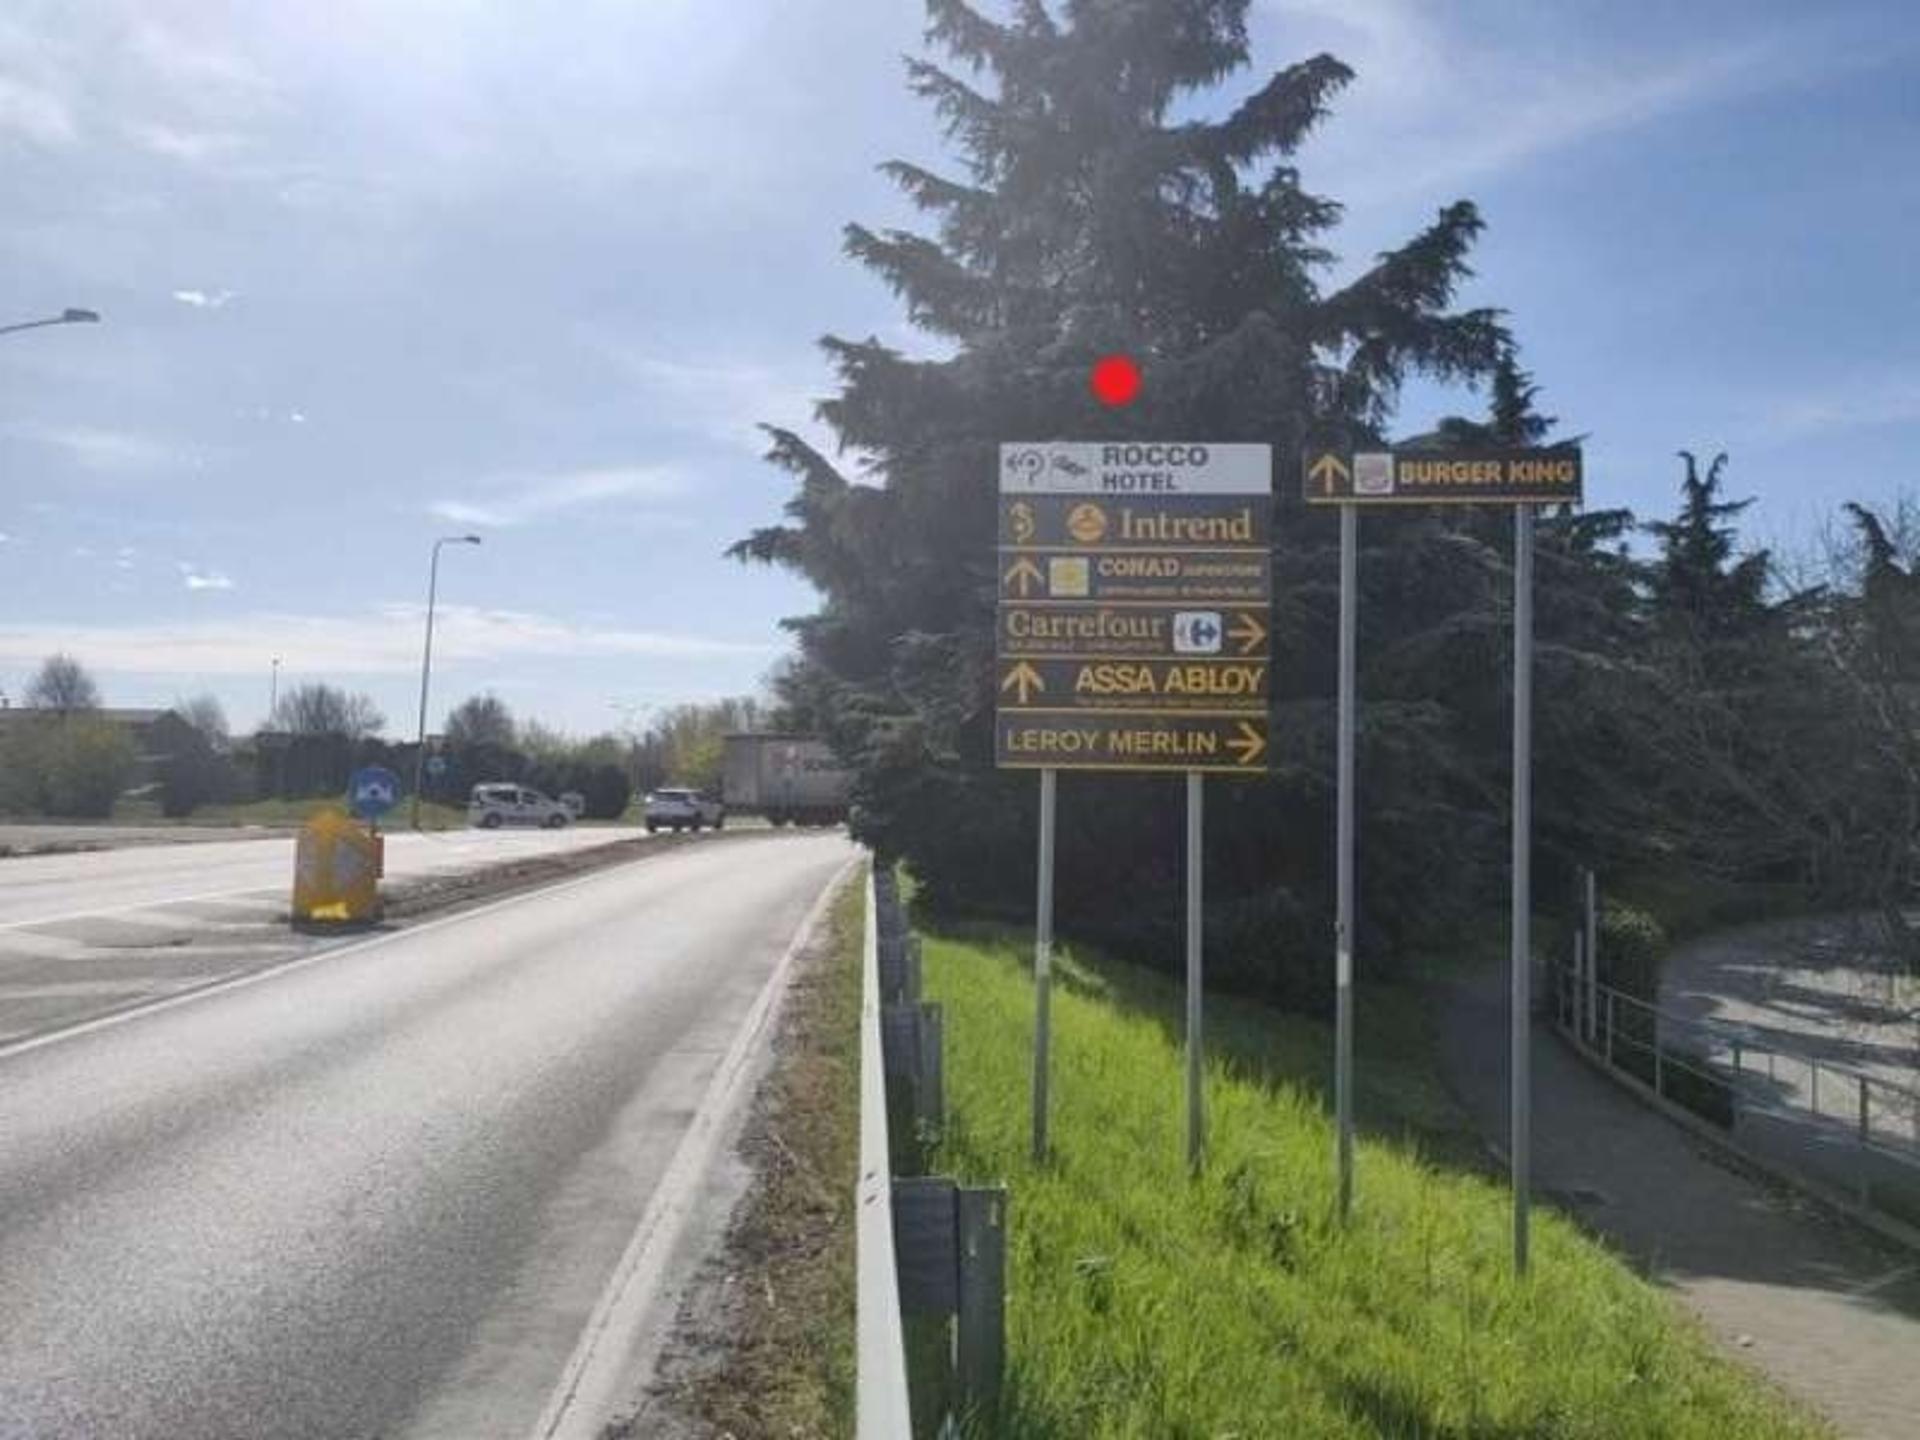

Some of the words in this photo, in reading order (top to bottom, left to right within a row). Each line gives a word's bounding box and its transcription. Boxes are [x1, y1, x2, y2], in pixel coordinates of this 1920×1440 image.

[1102, 446, 1209, 467] ROCCO
[1102, 472, 1180, 491] HOTEL
[1399, 461, 1502, 484] BURGER
[1508, 461, 1575, 483] KING
[1121, 508, 1252, 541] Intrend
[1006, 610, 1164, 638] Carrefour
[1075, 665, 1156, 693] ASSA
[1164, 666, 1264, 695] ABLOY
[1006, 730, 1099, 753] LEROY
[1109, 731, 1218, 754] MERLIN
